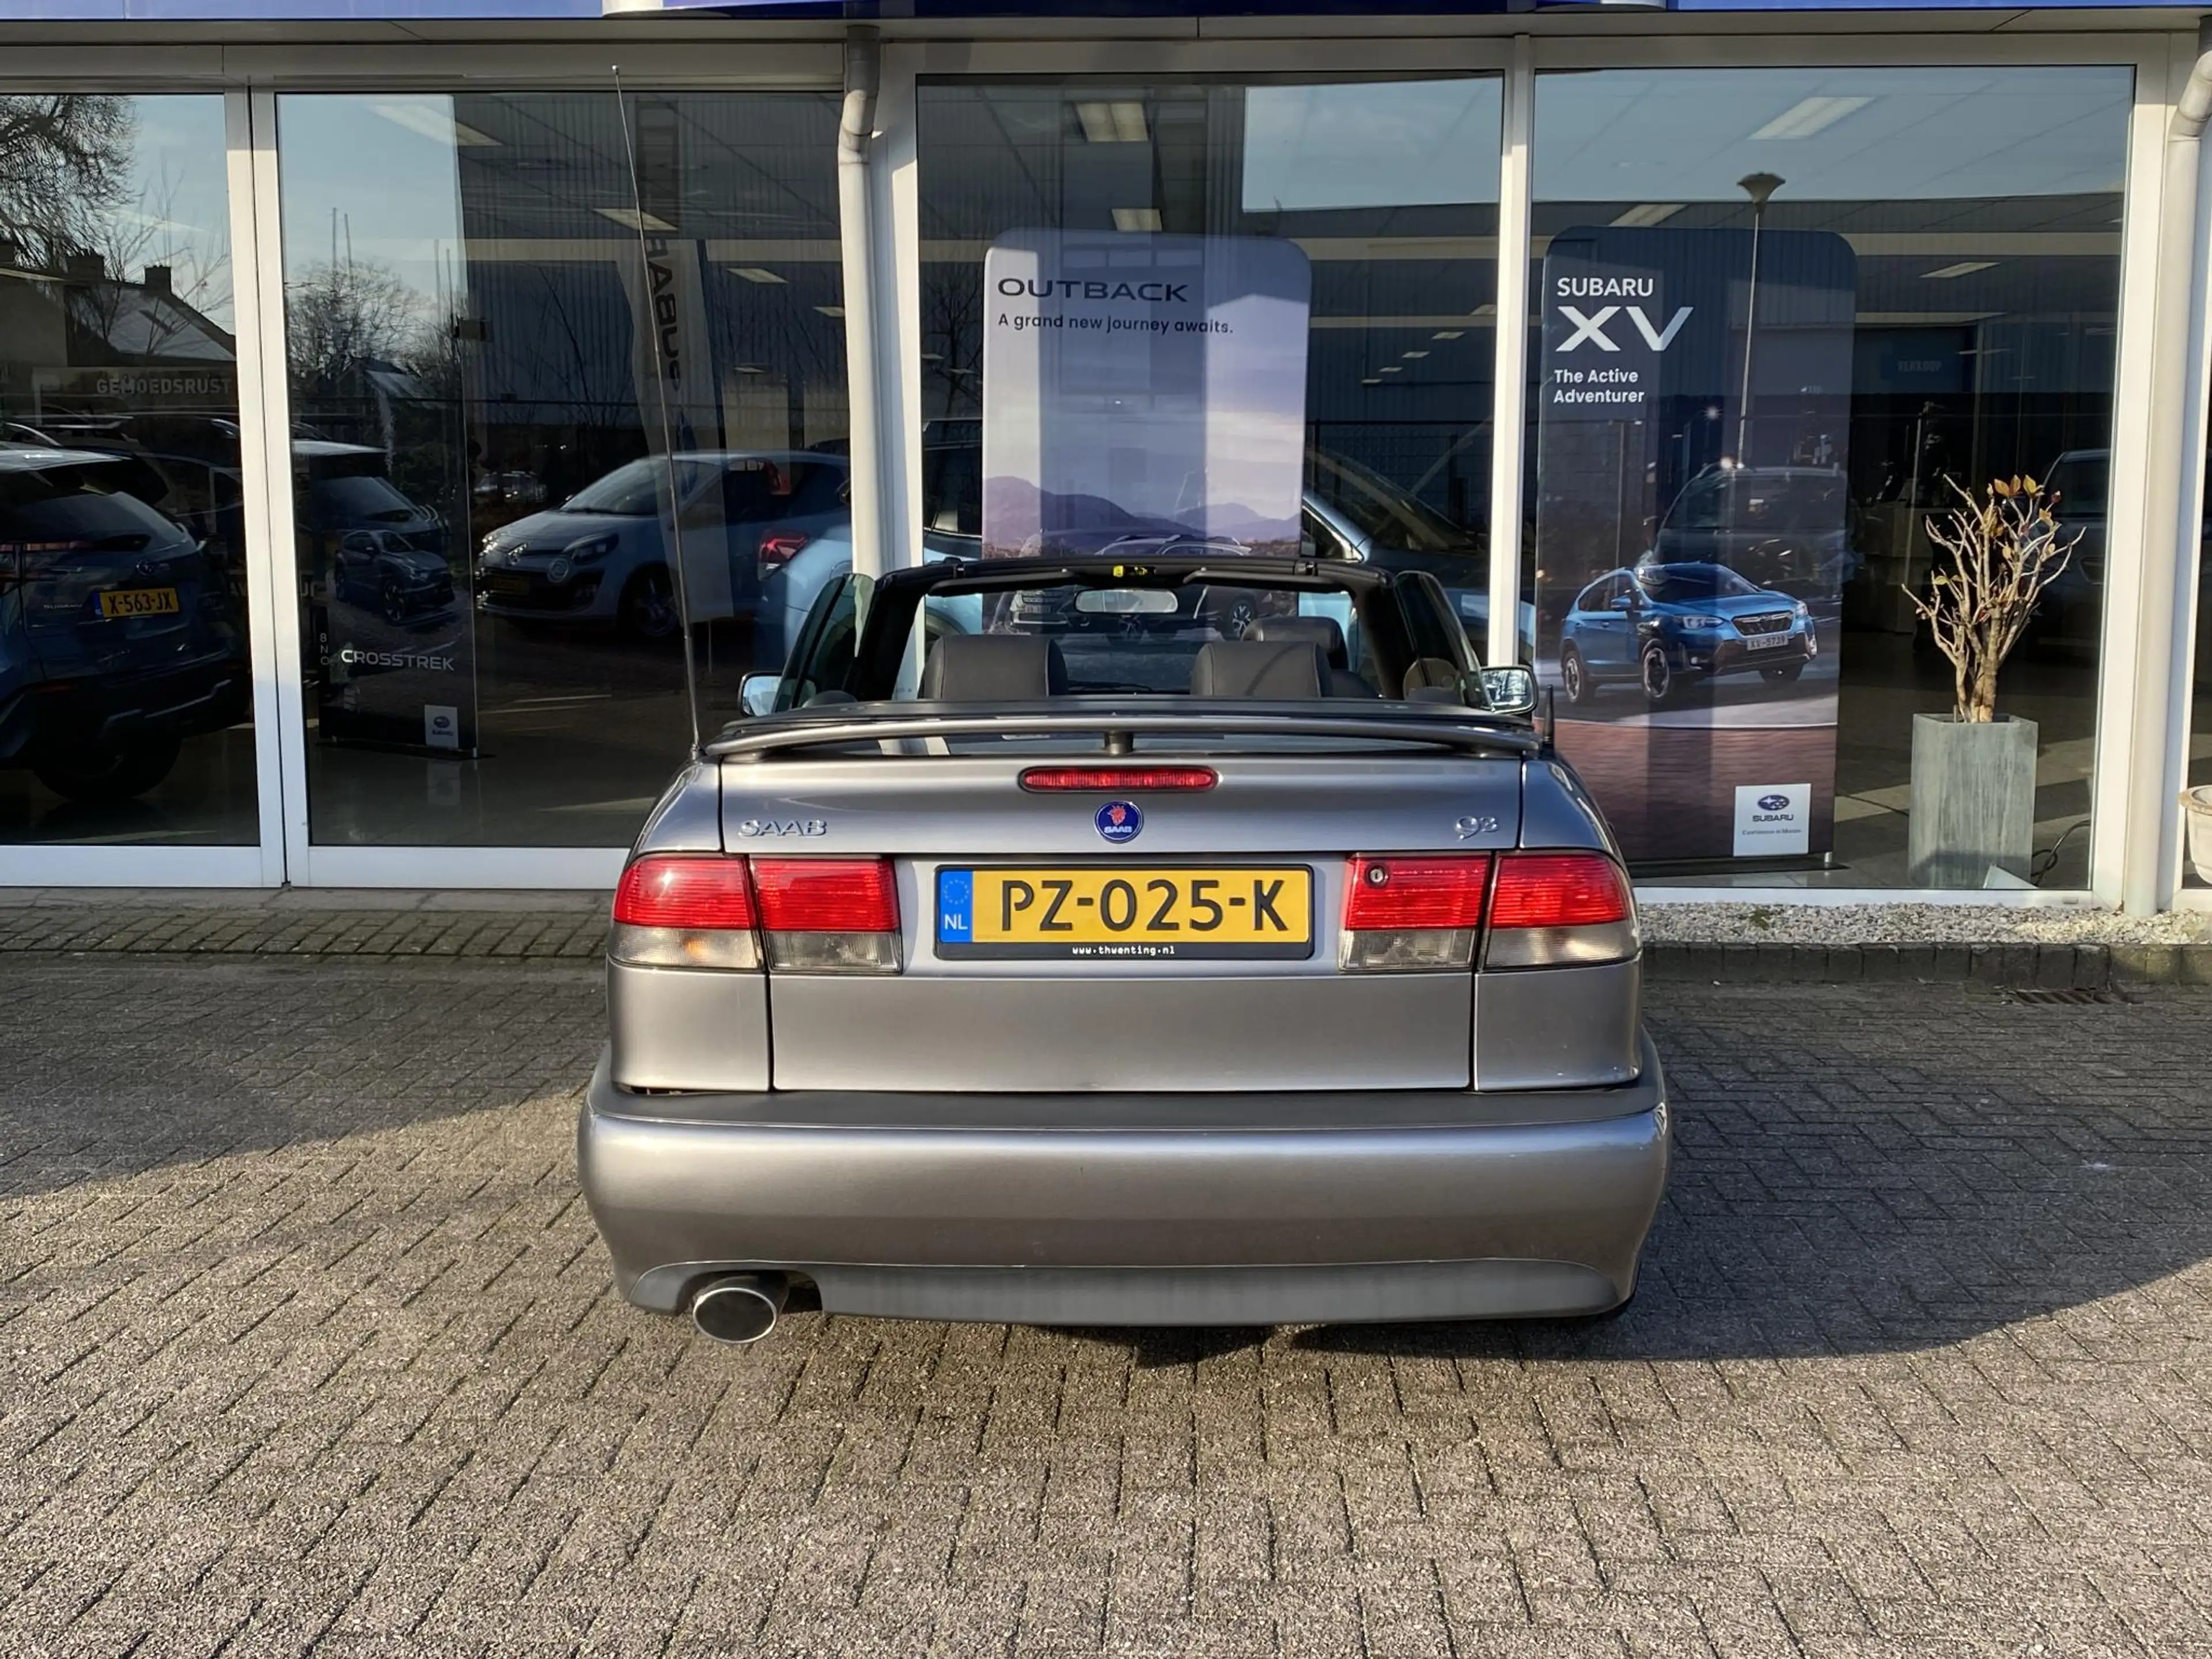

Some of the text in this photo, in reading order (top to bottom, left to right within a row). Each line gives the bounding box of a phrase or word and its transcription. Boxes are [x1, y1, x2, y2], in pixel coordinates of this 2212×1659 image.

[998, 278, 1190, 302] OUTBACK
[1556, 277, 1654, 297] SUBARU
[998, 313, 1234, 335] A grand new journey awaits.
[1555, 306, 1694, 352] XV
[1554, 368, 1639, 384] The Active
[96, 378, 232, 395] GEMOEDSRUST
[1553, 389, 1645, 404] Adventurer
[108, 591, 173, 615] X-563-JX
[341, 649, 455, 671] CROSSTREK
[1752, 814, 1794, 822] SUBARU
[736, 819, 828, 838] SAAB
[1104, 825, 1132, 834] SAAB
[1001, 878, 1289, 931] PZ-025-K
[944, 914, 968, 930] NL
[1072, 945, 1176, 957] www.thwenting.nl
